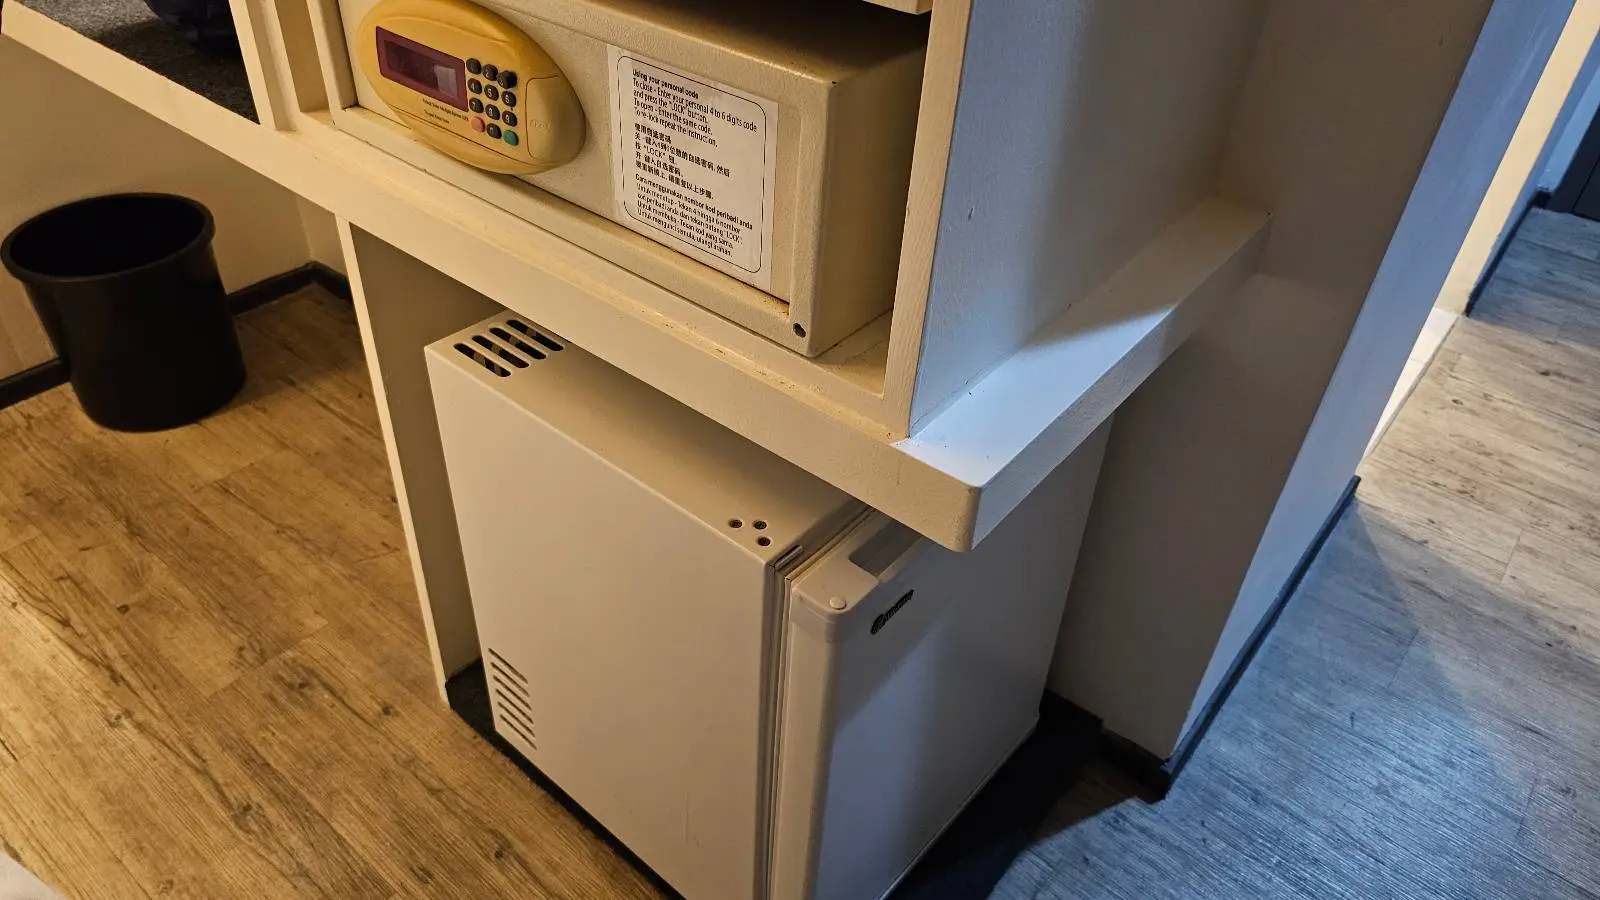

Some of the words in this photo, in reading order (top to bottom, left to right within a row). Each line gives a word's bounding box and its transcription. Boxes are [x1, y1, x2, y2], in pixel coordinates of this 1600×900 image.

[633, 68, 648, 81] Using
[649, 76, 660, 85] your
[662, 82, 684, 94] personal
[685, 88, 698, 99] code
[633, 78, 639, 87] To
[640, 82, 652, 92] close
[658, 86, 672, 99] Enter
[672, 94, 684, 104] your
[686, 99, 708, 114] personal
[714, 108, 720, 118] to
[726, 113, 742, 126] digits
[744, 121, 757, 132] code
[634, 89, 644, 98] and
[644, 93, 658, 105] press
[658, 98, 668, 108] the
[634, 97, 640, 106] To
[640, 102, 654, 112] open
[658, 106, 672, 119] Enter
[672, 112, 682, 124] the
[682, 118, 698, 130] same
[698, 124, 712, 136] code.
[634, 106, 640, 116] To
[641, 110, 658, 123] re-lock
[660, 118, 676, 131] repeat
[676, 124, 686, 134] the
[706, 204, 716, 214] kod
[716, 210, 738, 224] peribadi
[740, 219, 753, 230] anda
